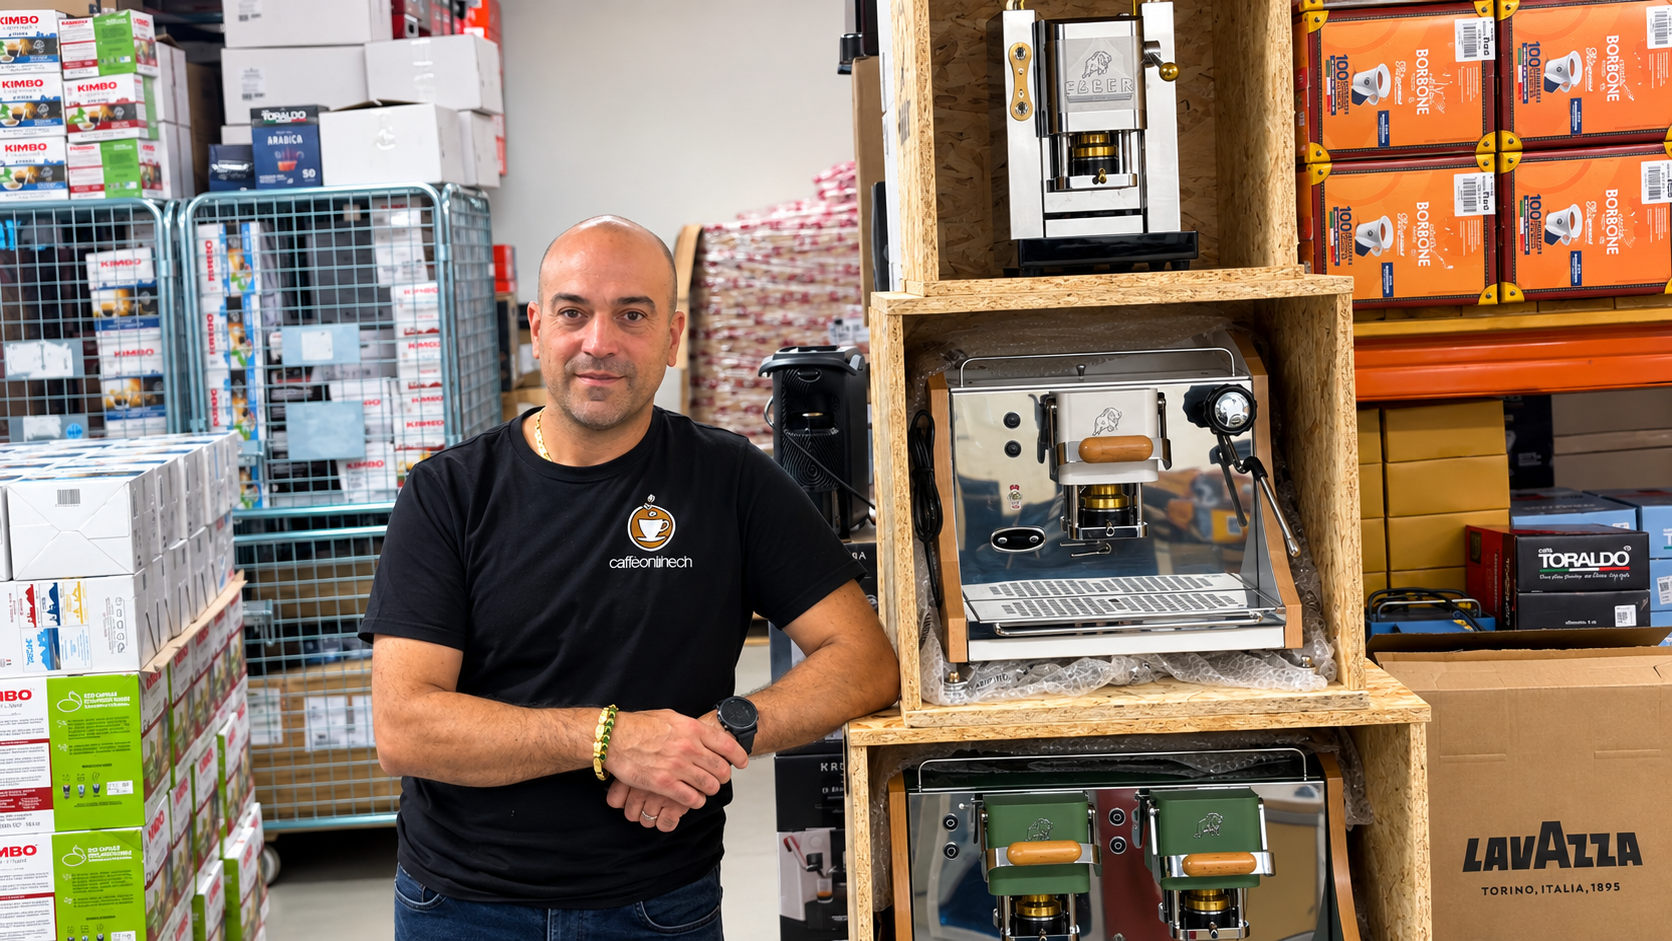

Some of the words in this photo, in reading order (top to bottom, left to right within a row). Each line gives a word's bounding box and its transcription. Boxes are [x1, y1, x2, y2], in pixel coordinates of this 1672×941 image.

[1336, 54, 1349, 81] 100
[1528, 41, 1541, 69] 100
[1606, 35, 1620, 102] BORBONE
[2, 79, 44, 89] KIMBO
[77, 81, 118, 92] KIMBO
[1416, 48, 1429, 115] BORBONE
[5, 143, 47, 153] KIMBO
[267, 134, 303, 146] ARABICA
[1339, 206, 1352, 232] 100
[1530, 194, 1542, 221] 100
[1416, 202, 1431, 267] BORBONE
[1605, 189, 1619, 255] BORBONE
[1538, 551, 1630, 568] TORALDO
[1462, 821, 1643, 873] LAVAZZA
[1481, 885, 1538, 896] TORINO,
[1541, 884, 1589, 894] ITALIA,
[1591, 882, 1621, 892] 1895
